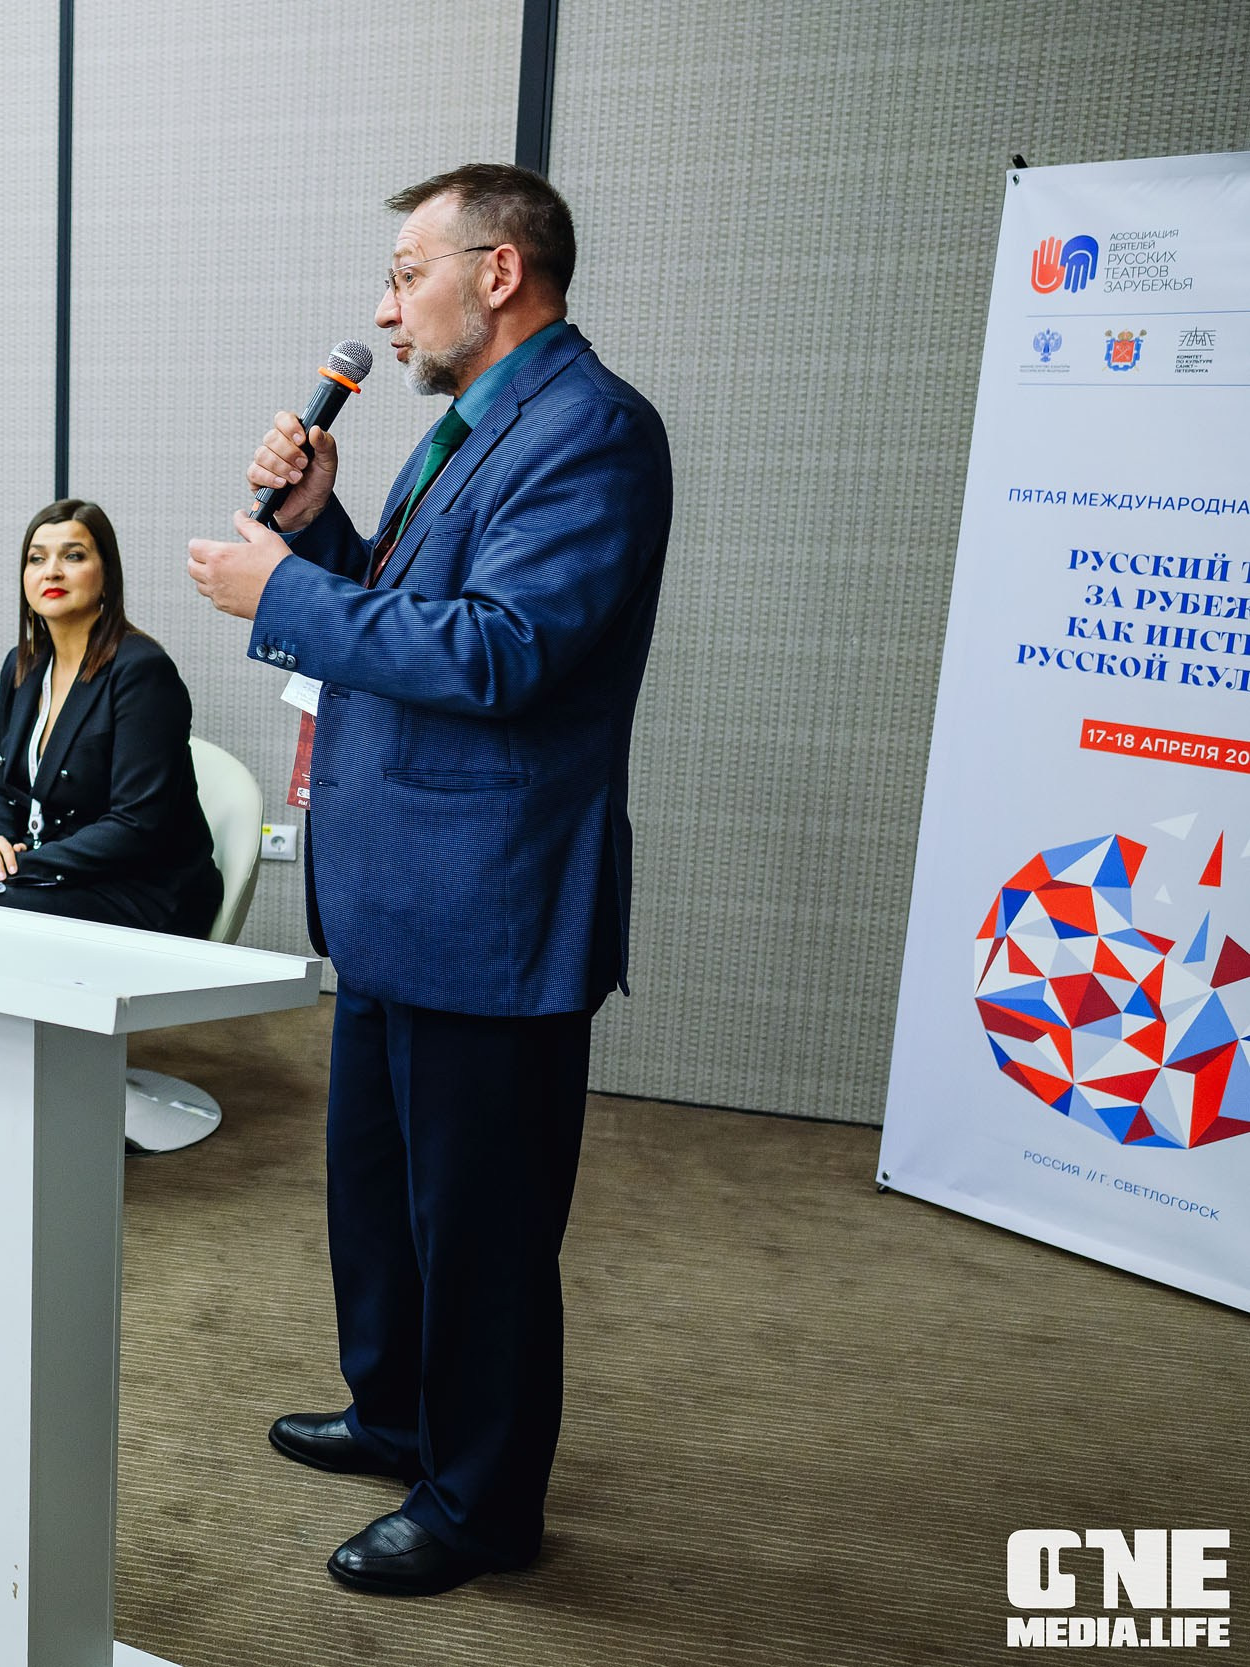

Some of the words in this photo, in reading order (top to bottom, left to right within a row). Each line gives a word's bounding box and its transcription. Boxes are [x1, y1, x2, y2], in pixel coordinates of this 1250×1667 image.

[1109, 240, 1156, 252] ДЕЯТЕЛЕЙ
[1110, 229, 1179, 241] АССОЦИАЦИЯ
[1107, 250, 1177, 266] РУССКИХ
[1103, 277, 1193, 293] ЗАРУБЕЖЬЯ
[1104, 265, 1169, 280] ТЕАТРОВ
[1008, 488, 1067, 505] ПЯТАЯ
[1072, 491, 1250, 516] МЕЖДУНАРОДНА
[1067, 548, 1232, 583] РУССКИЙ
[1085, 584, 1125, 609] ЗА
[1066, 616, 1135, 644] КАК
[1015, 643, 1170, 682] РУССКОЙ
[1087, 728, 1135, 750] 17-18
[1140, 736, 1219, 761] АПРЕЛЯ
[1224, 748, 1250, 766] 20
[1023, 1150, 1081, 1177] РОССИЯ
[1100, 1173, 1110, 1187] Г.
[1114, 1178, 1221, 1222] СВЕТЛОГОРСК
